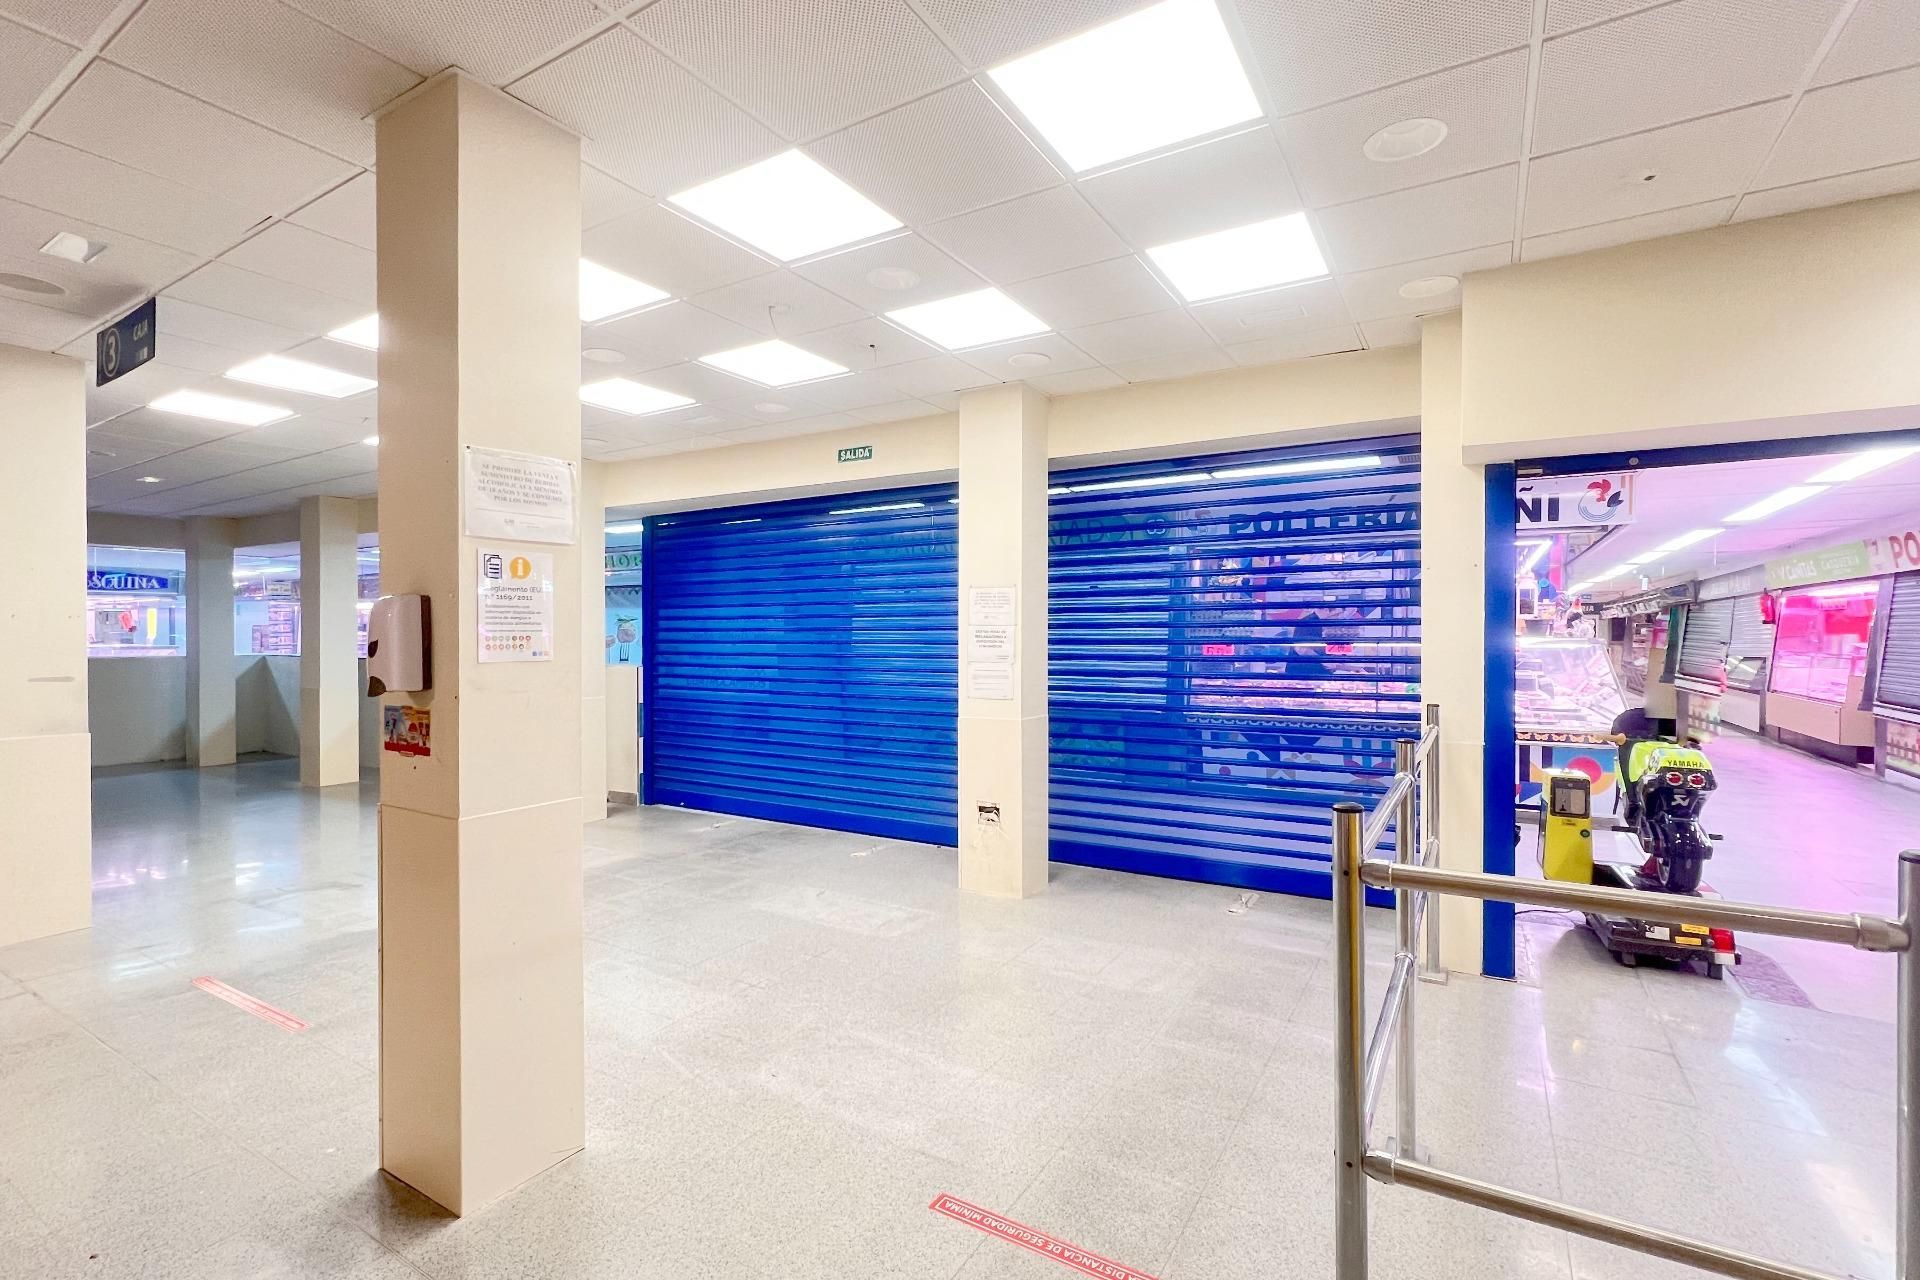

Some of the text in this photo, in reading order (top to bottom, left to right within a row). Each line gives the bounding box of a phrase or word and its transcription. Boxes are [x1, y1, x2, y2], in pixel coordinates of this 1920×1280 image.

[107, 334, 117, 372] 3
[840, 448, 870, 461] SALIDA
[88, 572, 160, 590] SQUINA
[485, 585, 529, 595] eglamento
[495, 593, 534, 602] 1169/2011
[1667, 759, 1705, 768] YAMAHA
[943, 1200, 983, 1221] MÍNIMA
[982, 1216, 1045, 1247] SEGURIDAD
[1046, 1243, 1063, 1254] DE
[1063, 1250, 1126, 1280] DISTANCIA
